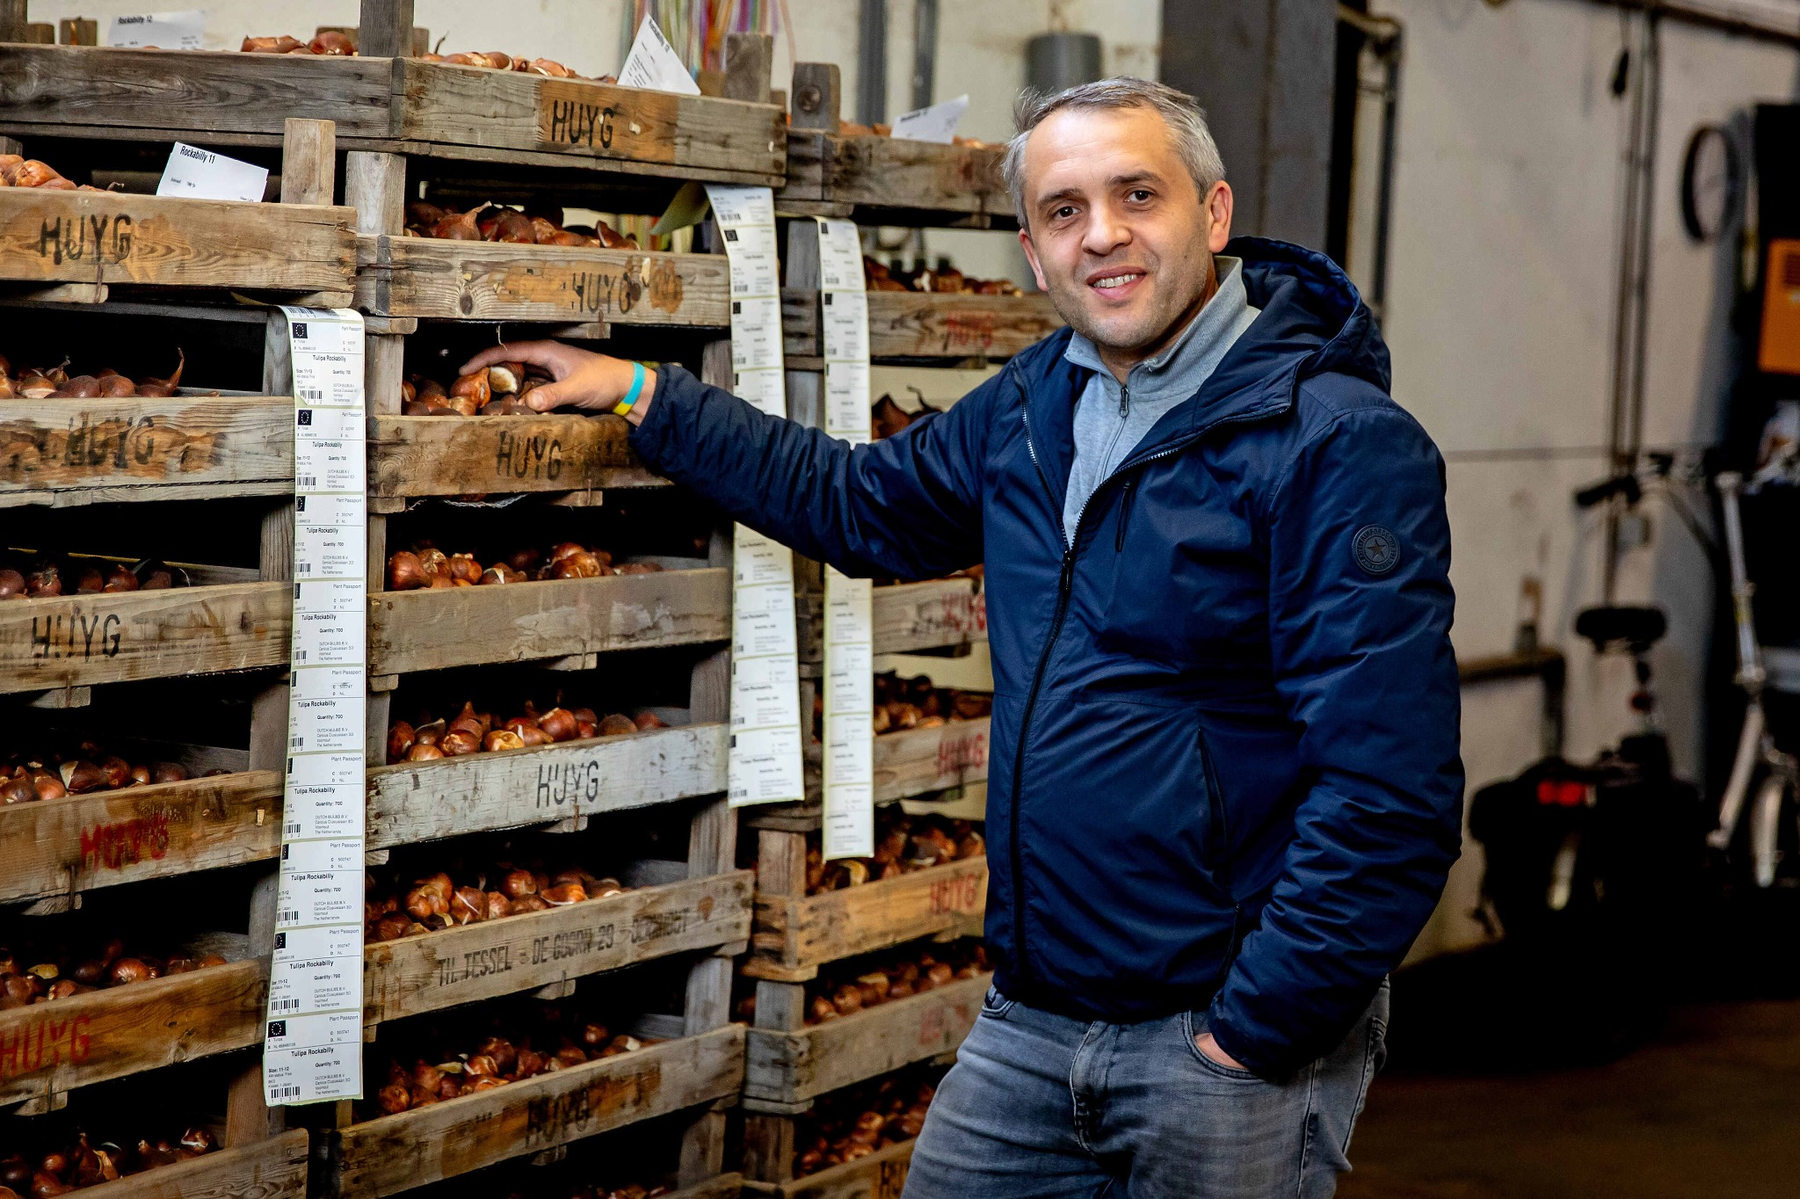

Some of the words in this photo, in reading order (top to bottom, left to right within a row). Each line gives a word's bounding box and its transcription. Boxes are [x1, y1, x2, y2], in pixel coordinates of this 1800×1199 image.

[550, 99, 615, 149] HUYG
[180, 146, 208, 164] Rockabilly
[208, 154, 216, 164] 11
[40, 213, 131, 265] HUYG
[573, 271, 632, 314] HUYG
[496, 430, 562, 481] HUYG
[30, 612, 121, 663] HUYG
[536, 760, 599, 808] HUYG
[464, 945, 512, 980] TESSEL
[532, 936, 550, 966] DE
[0, 1015, 91, 1077] HUYG
